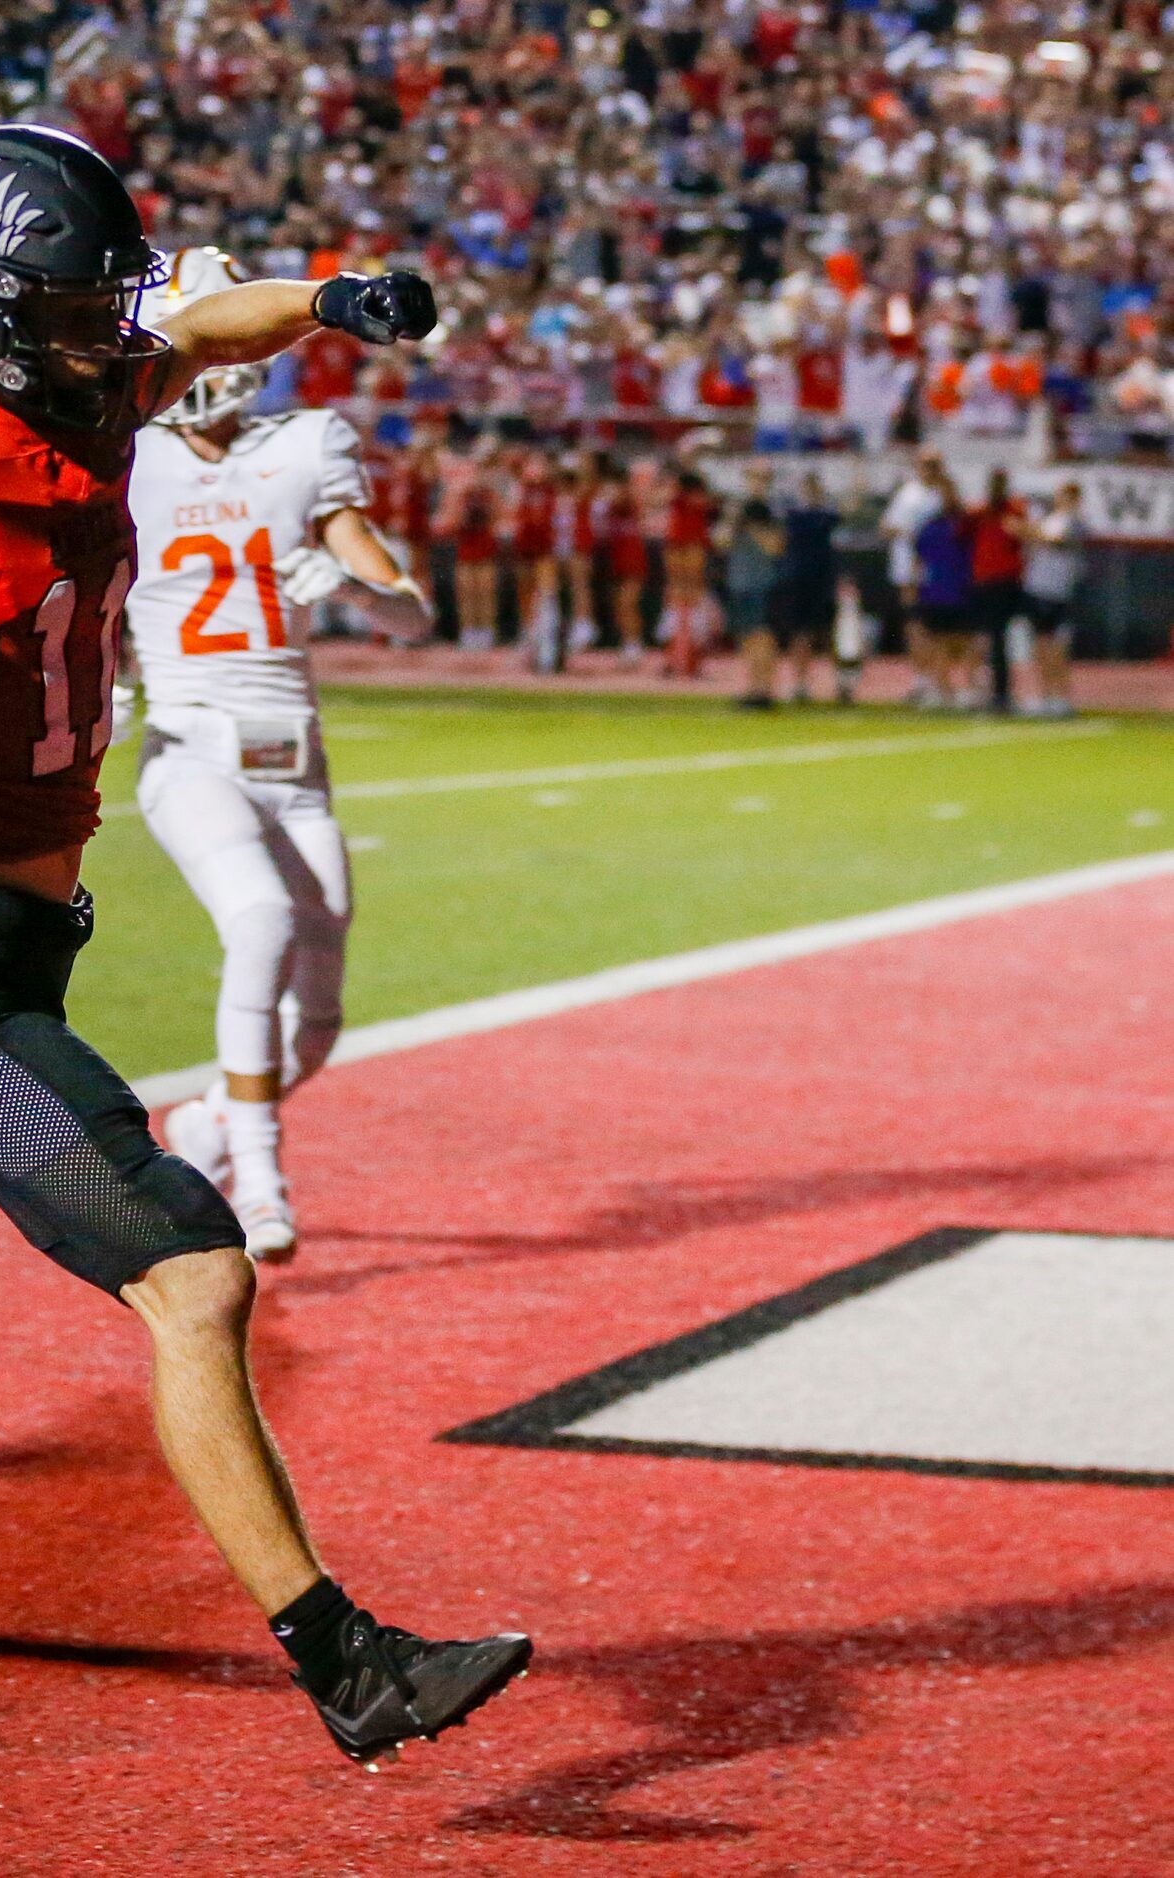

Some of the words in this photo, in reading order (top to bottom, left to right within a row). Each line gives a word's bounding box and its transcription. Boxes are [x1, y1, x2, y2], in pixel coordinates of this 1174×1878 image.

[174, 500, 250, 527] CELINA
[160, 527, 286, 656] 21
[32, 557, 130, 777] 11
